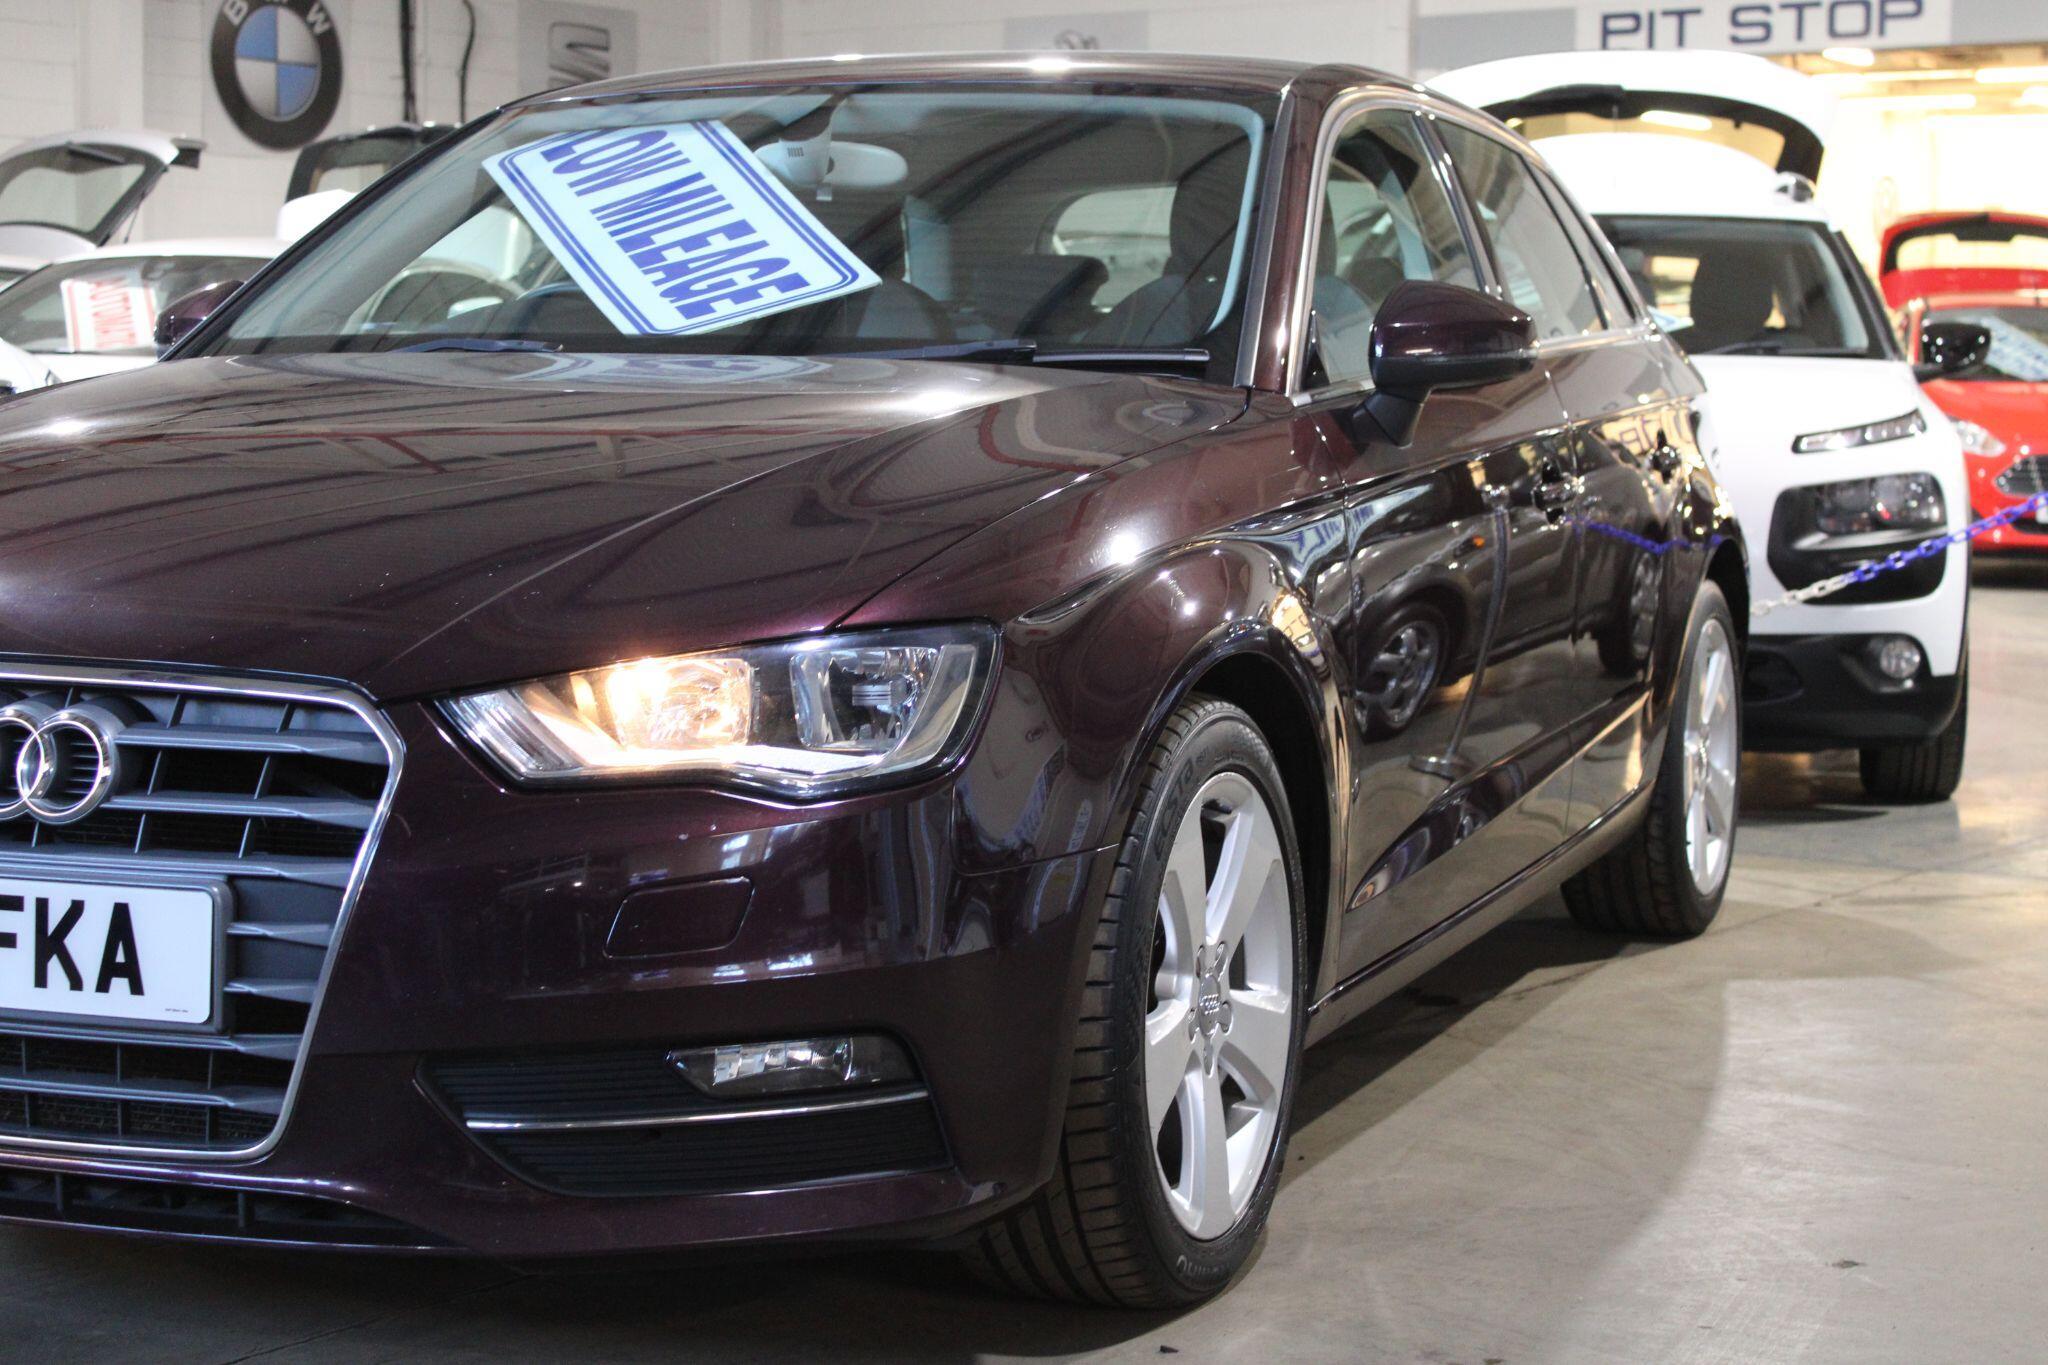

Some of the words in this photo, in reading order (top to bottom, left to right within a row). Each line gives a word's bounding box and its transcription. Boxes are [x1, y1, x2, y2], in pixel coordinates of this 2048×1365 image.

[223, 0, 332, 34] BW
[1602, 9, 1701, 50] PIT
[1729, 0, 1922, 44] STOP
[541, 128, 691, 197] LOW
[590, 171, 811, 320] MILEAGE
